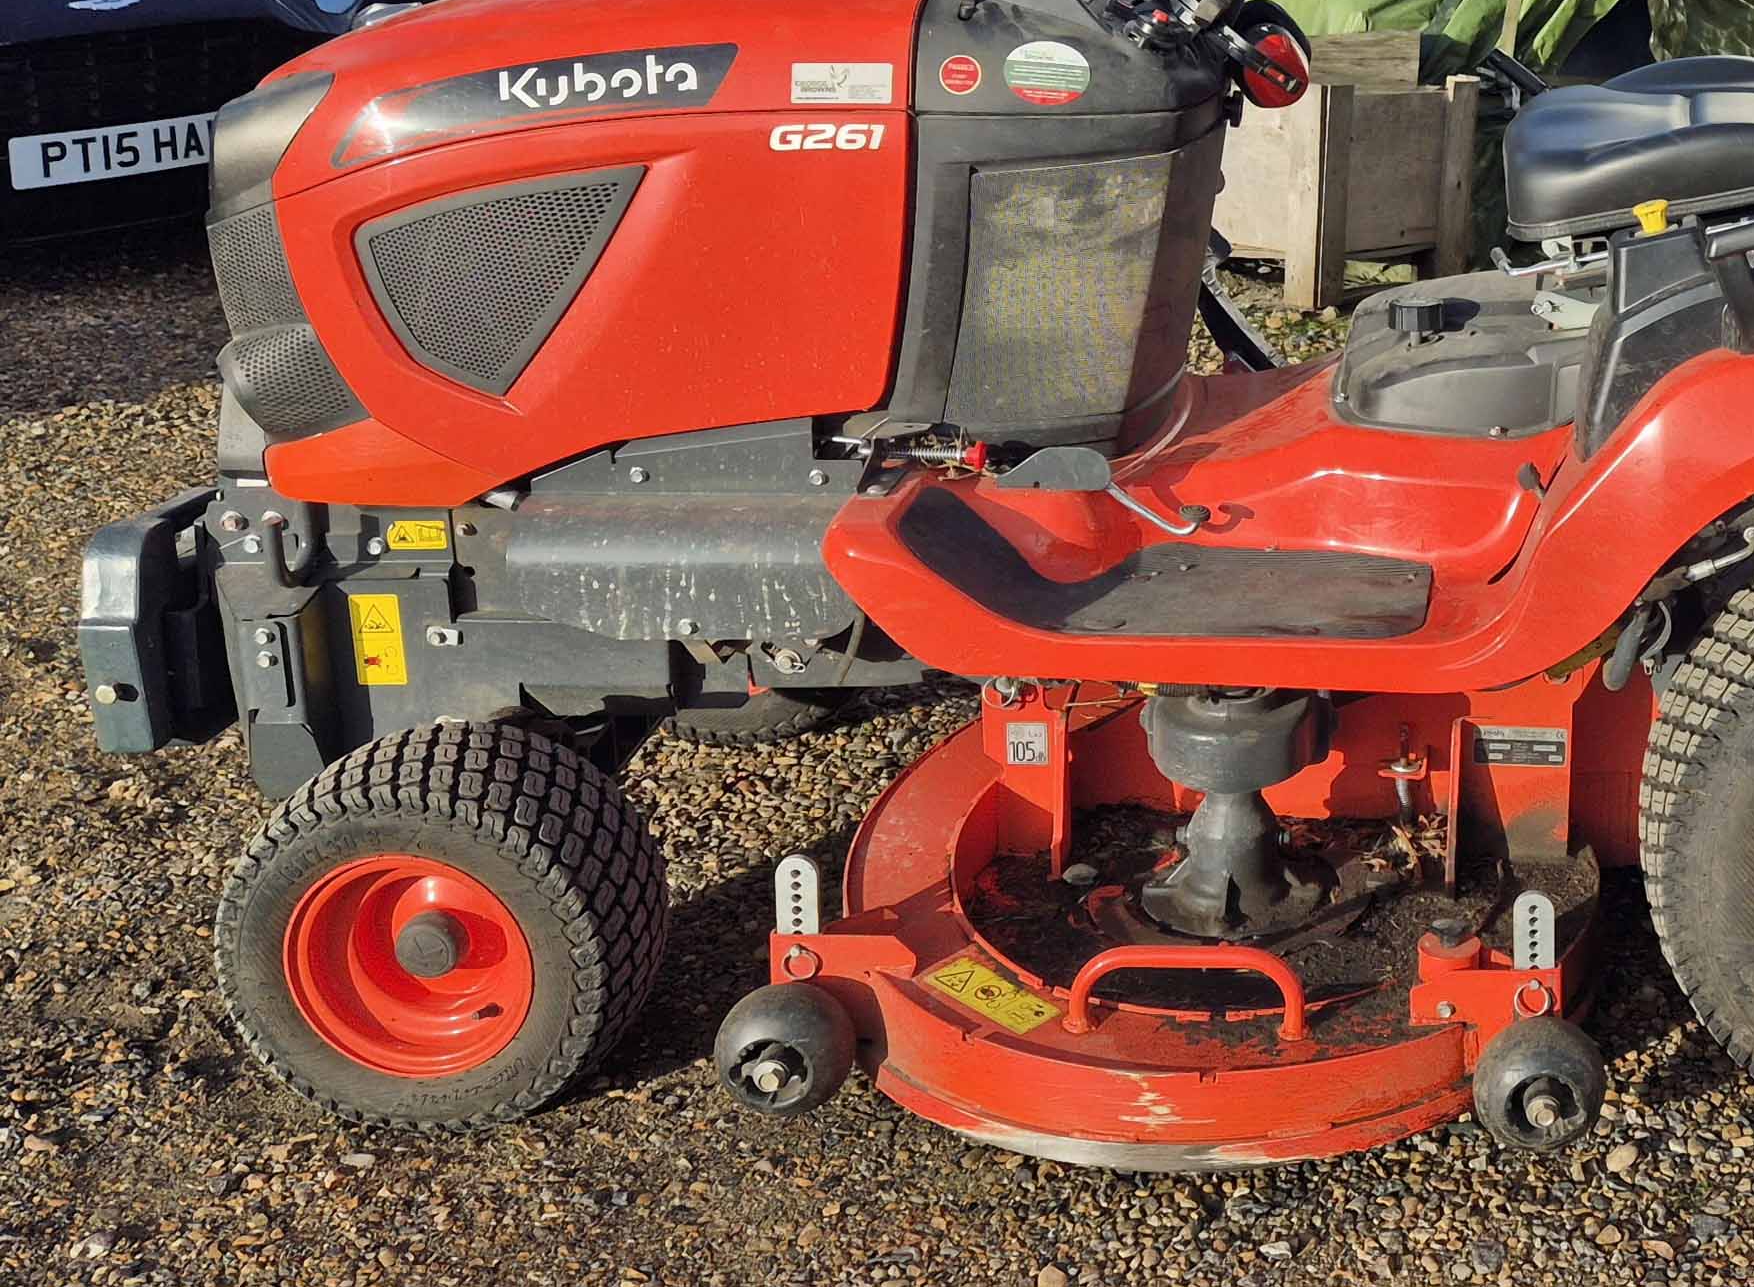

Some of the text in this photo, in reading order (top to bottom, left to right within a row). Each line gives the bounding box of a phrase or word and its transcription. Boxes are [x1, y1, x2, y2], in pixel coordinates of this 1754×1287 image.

[499, 54, 699, 109] Kubota
[41, 131, 140, 178] PT15
[769, 123, 886, 151] G261
[1009, 741, 1036, 762] 105
